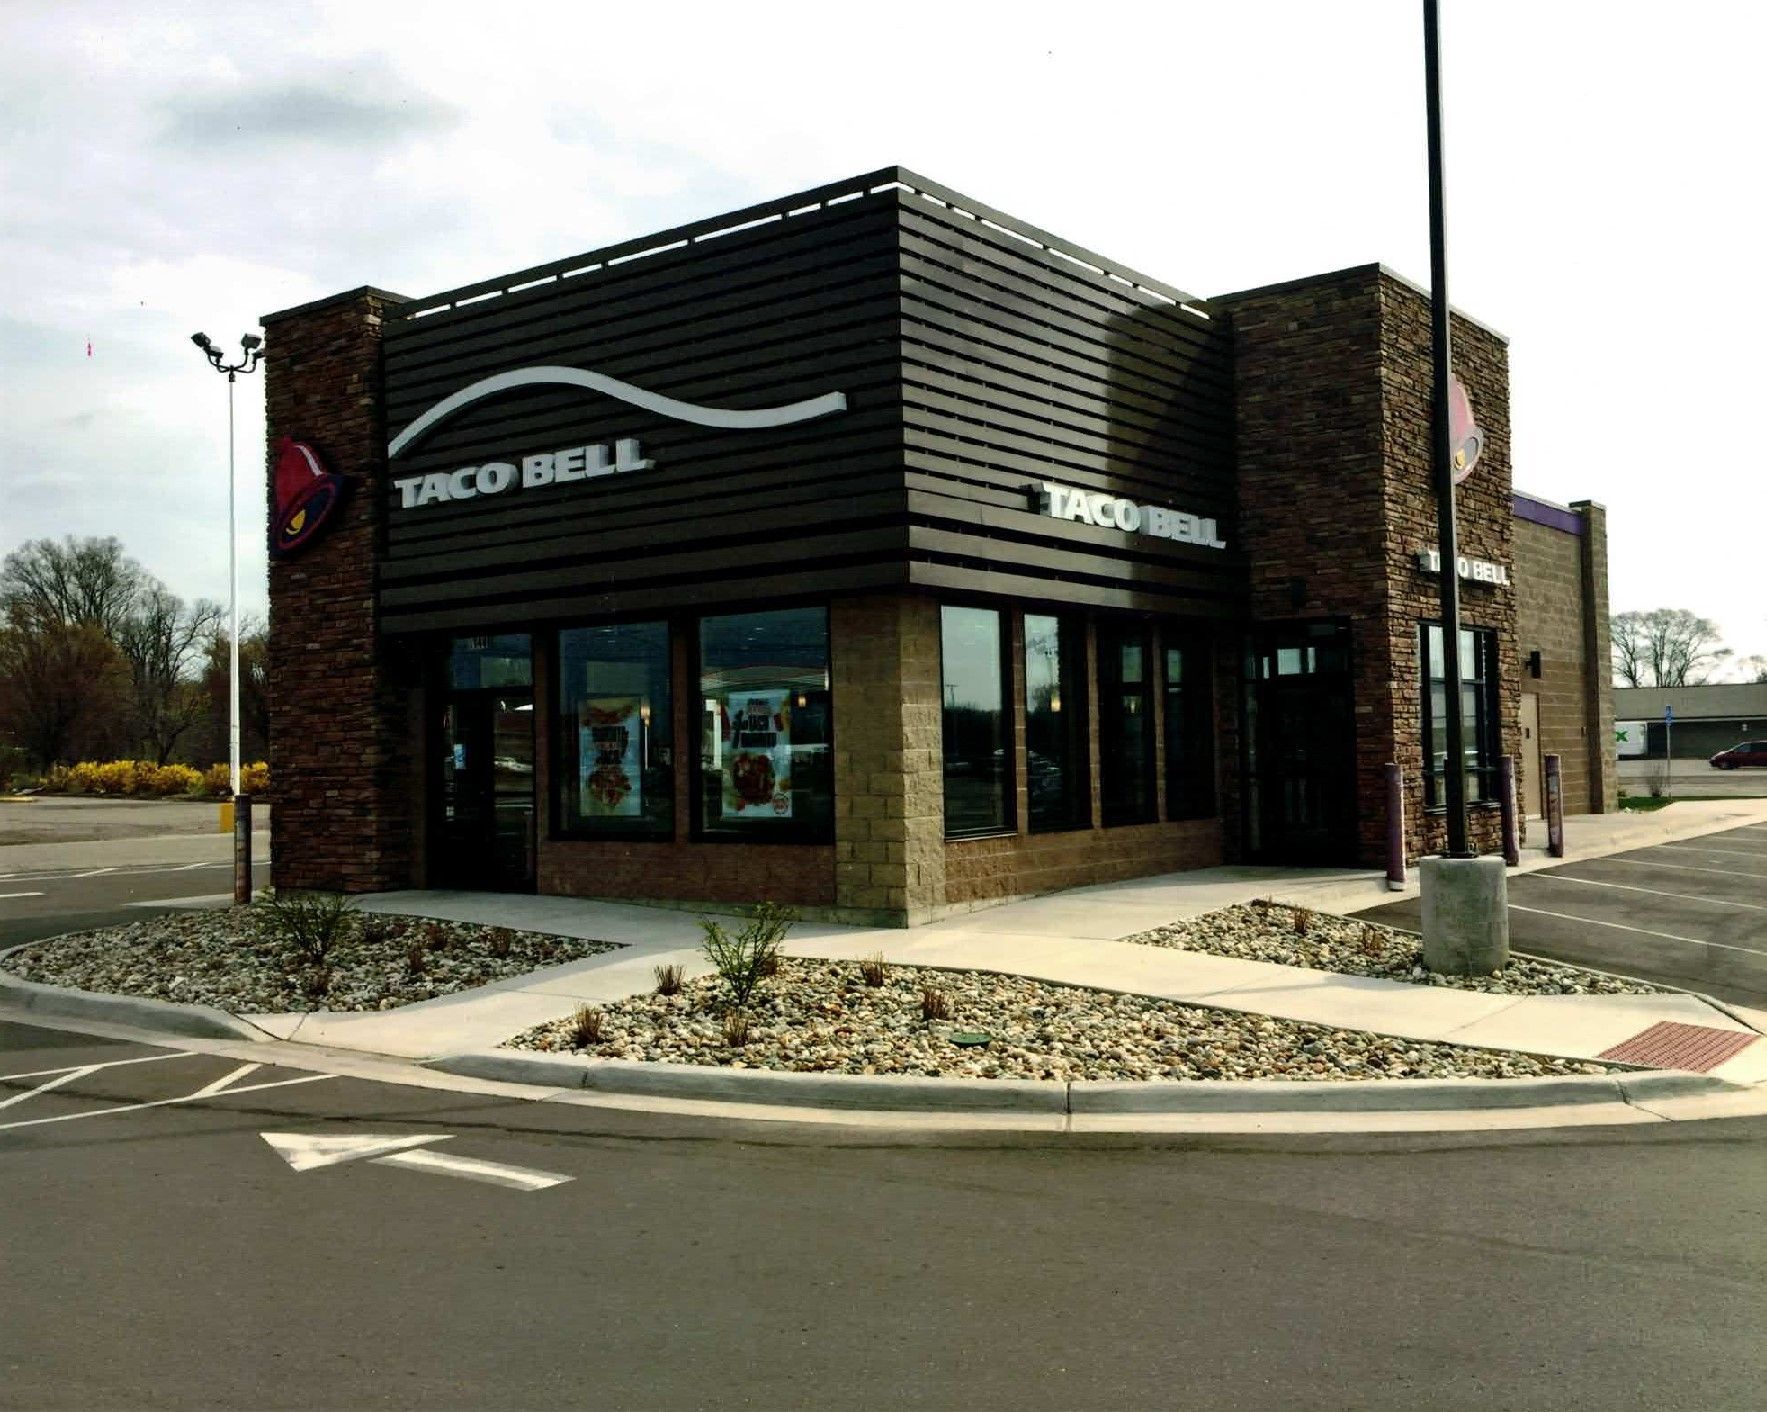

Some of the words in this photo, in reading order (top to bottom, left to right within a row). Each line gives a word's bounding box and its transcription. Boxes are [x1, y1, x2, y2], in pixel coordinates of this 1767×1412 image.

[394, 462, 517, 508] TACO
[522, 438, 654, 488] BELL
[1039, 481, 1142, 533] TACO
[1141, 506, 1227, 549] BELL
[1472, 558, 1511, 587] BELL
